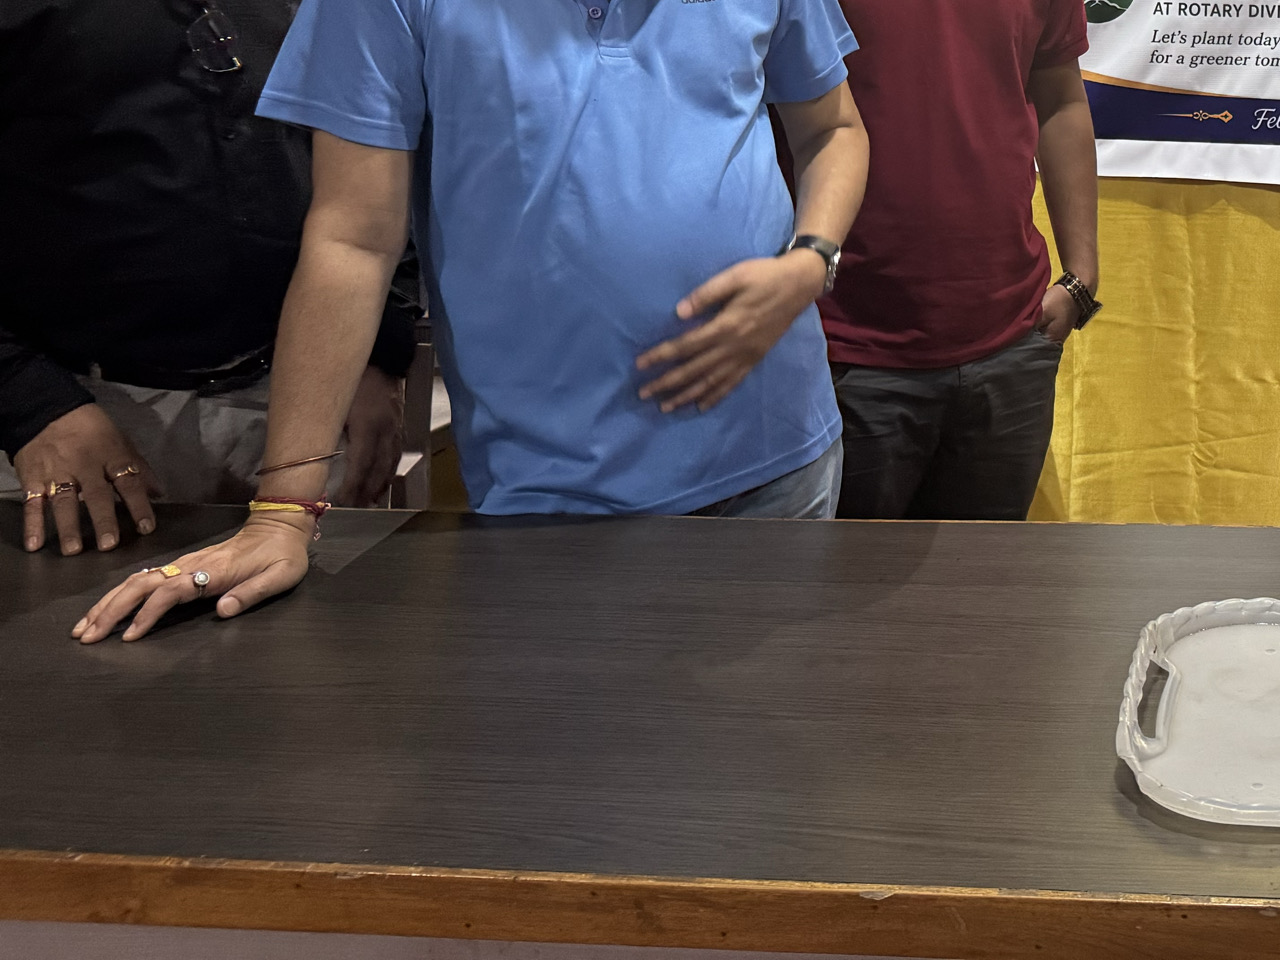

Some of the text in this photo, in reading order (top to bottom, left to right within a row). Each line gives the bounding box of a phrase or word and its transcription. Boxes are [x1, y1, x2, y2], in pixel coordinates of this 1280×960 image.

[1153, 2, 1172, 16] AT
[1178, 3, 1243, 18] ROTARY
[1191, 31, 1233, 47] plant
[1149, 50, 1173, 65] for
[1176, 55, 1185, 65] a
[1189, 54, 1250, 68] greener
